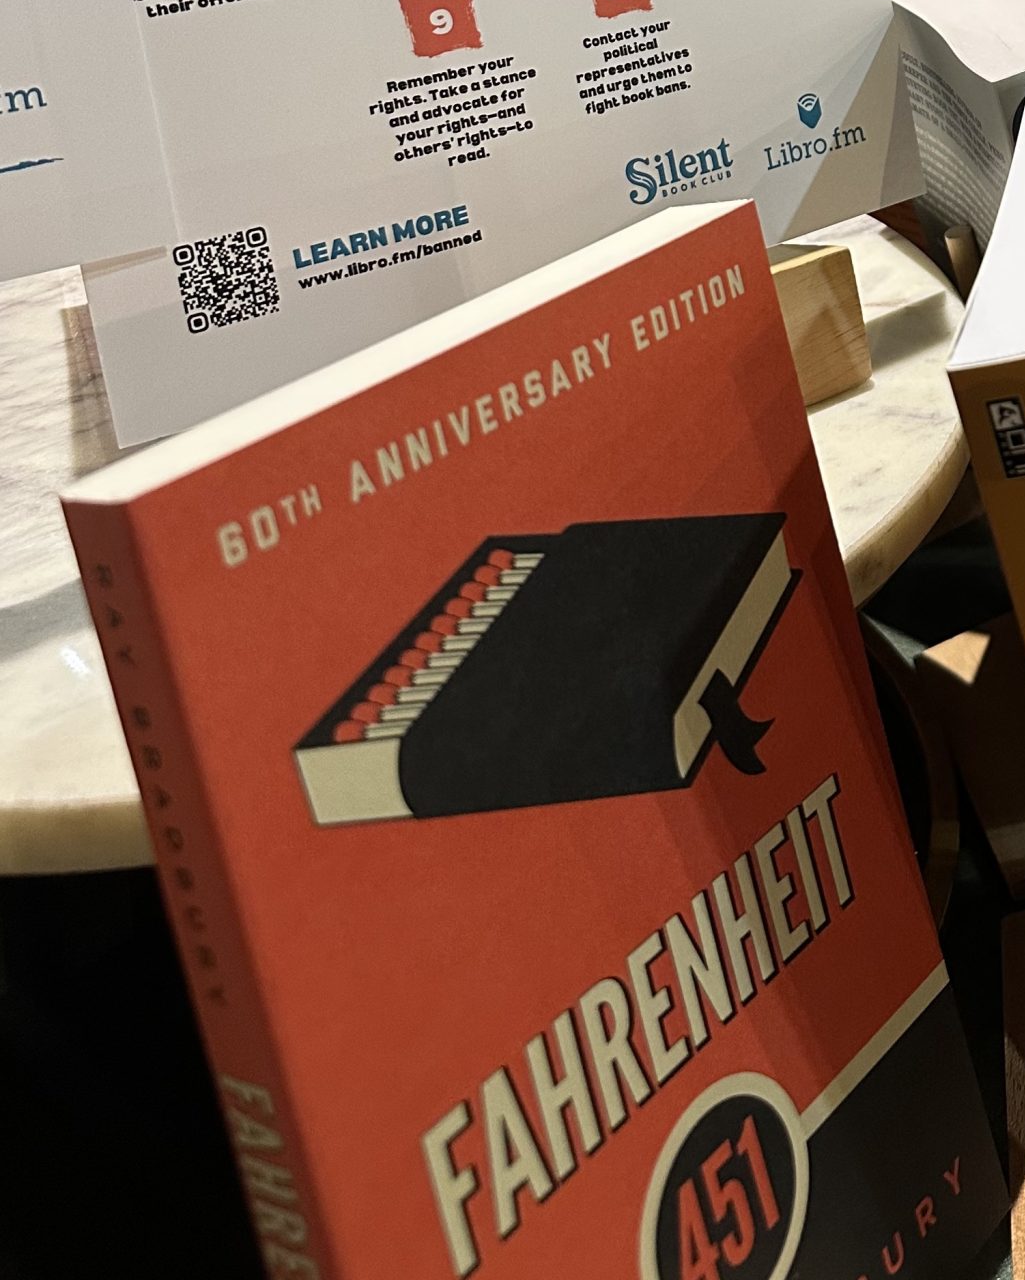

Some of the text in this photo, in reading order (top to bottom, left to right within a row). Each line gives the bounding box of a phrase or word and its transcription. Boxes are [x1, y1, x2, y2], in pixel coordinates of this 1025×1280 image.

[429, 9, 453, 35] 9
[582, 21, 671, 49] Contact your
[575, 47, 691, 85] representatives
[602, 37, 659, 63] political
[369, 68, 537, 116] rights. Take a stance
[386, 56, 514, 94] Remember your
[764, 126, 866, 170] Libro.fm
[625, 138, 734, 205] Silent
[662, 170, 732, 198] BOOK CLUB
[292, 205, 469, 269] LEARN MORE
[298, 230, 482, 289] www.libro.fm/banned
[349, 333, 613, 503] ANNIVERSARY
[631, 265, 746, 351] EDITION
[420, 772, 856, 1279] FAHRENHEIT
[678, 1114, 780, 1280] 451
